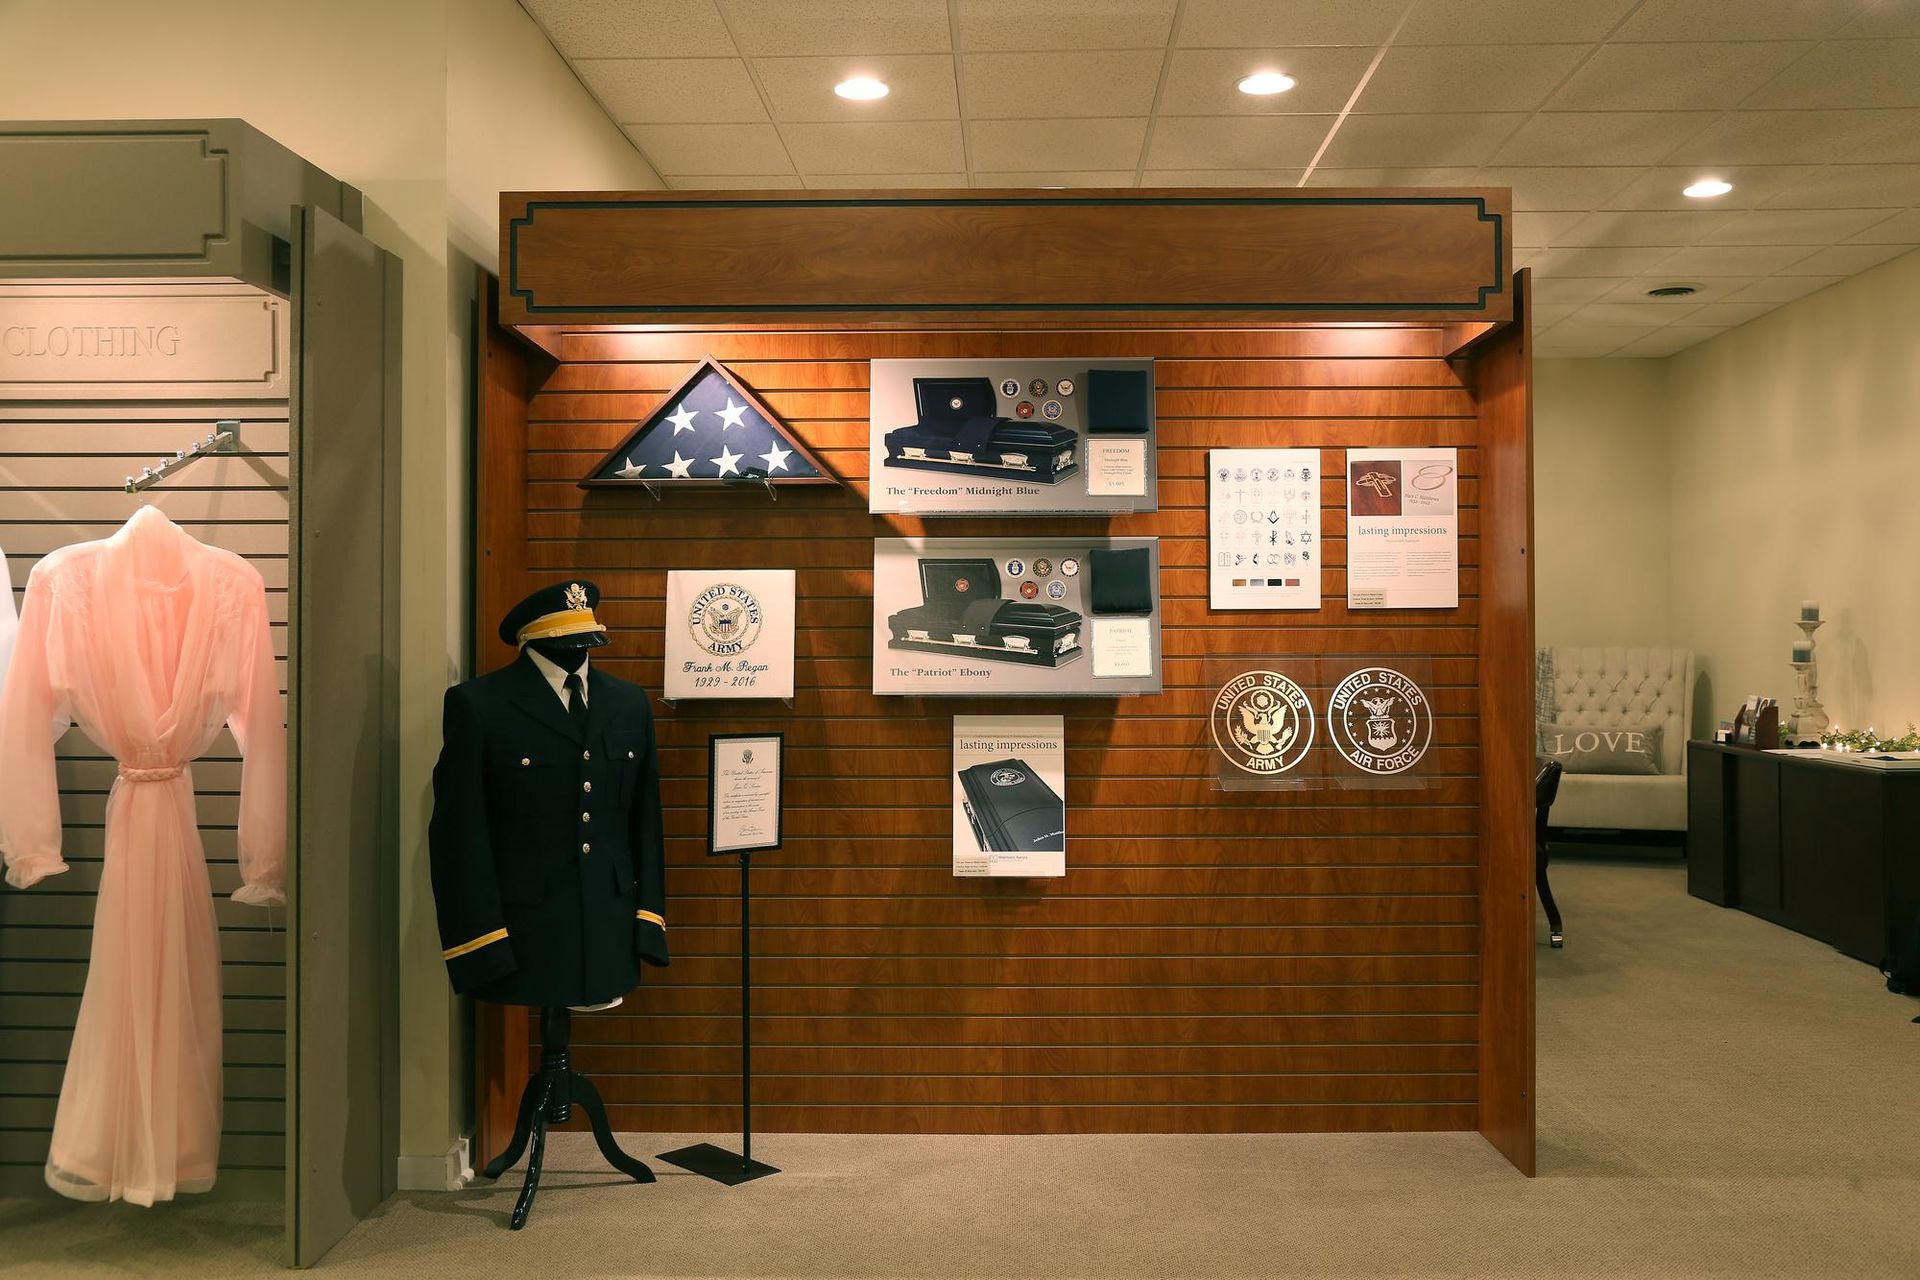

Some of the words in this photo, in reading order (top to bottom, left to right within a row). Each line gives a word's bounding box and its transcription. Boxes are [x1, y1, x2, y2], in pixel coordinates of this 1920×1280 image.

[3, 325, 181, 357] CLOTHING
[886, 486, 906, 496] The
[965, 486, 1013, 497] Midnight
[1016, 486, 1040, 496] Blue
[1358, 525, 1390, 538] lasting
[1392, 525, 1448, 538] impressions
[692, 587, 726, 625] UNITED
[729, 587, 759, 625] STATES
[708, 640, 744, 654] ARMY
[682, 661, 714, 673] Frank
[715, 661, 733, 672] M.
[889, 667, 910, 677] The
[960, 667, 992, 678] Ebony
[695, 676, 721, 688] 1929
[731, 676, 757, 687] 2016
[1217, 675, 1256, 711] UNITED
[1263, 674, 1306, 711] STATES
[1333, 672, 1371, 711] UNITED
[1378, 671, 1423, 707] STATES
[960, 739, 994, 753] lasting
[996, 739, 1058, 753] impressions
[1553, 730, 1646, 755] LOVE
[1246, 755, 1285, 771] ARMY
[1350, 749, 1373, 768] AIR
[1376, 745, 1420, 771] FORCE
